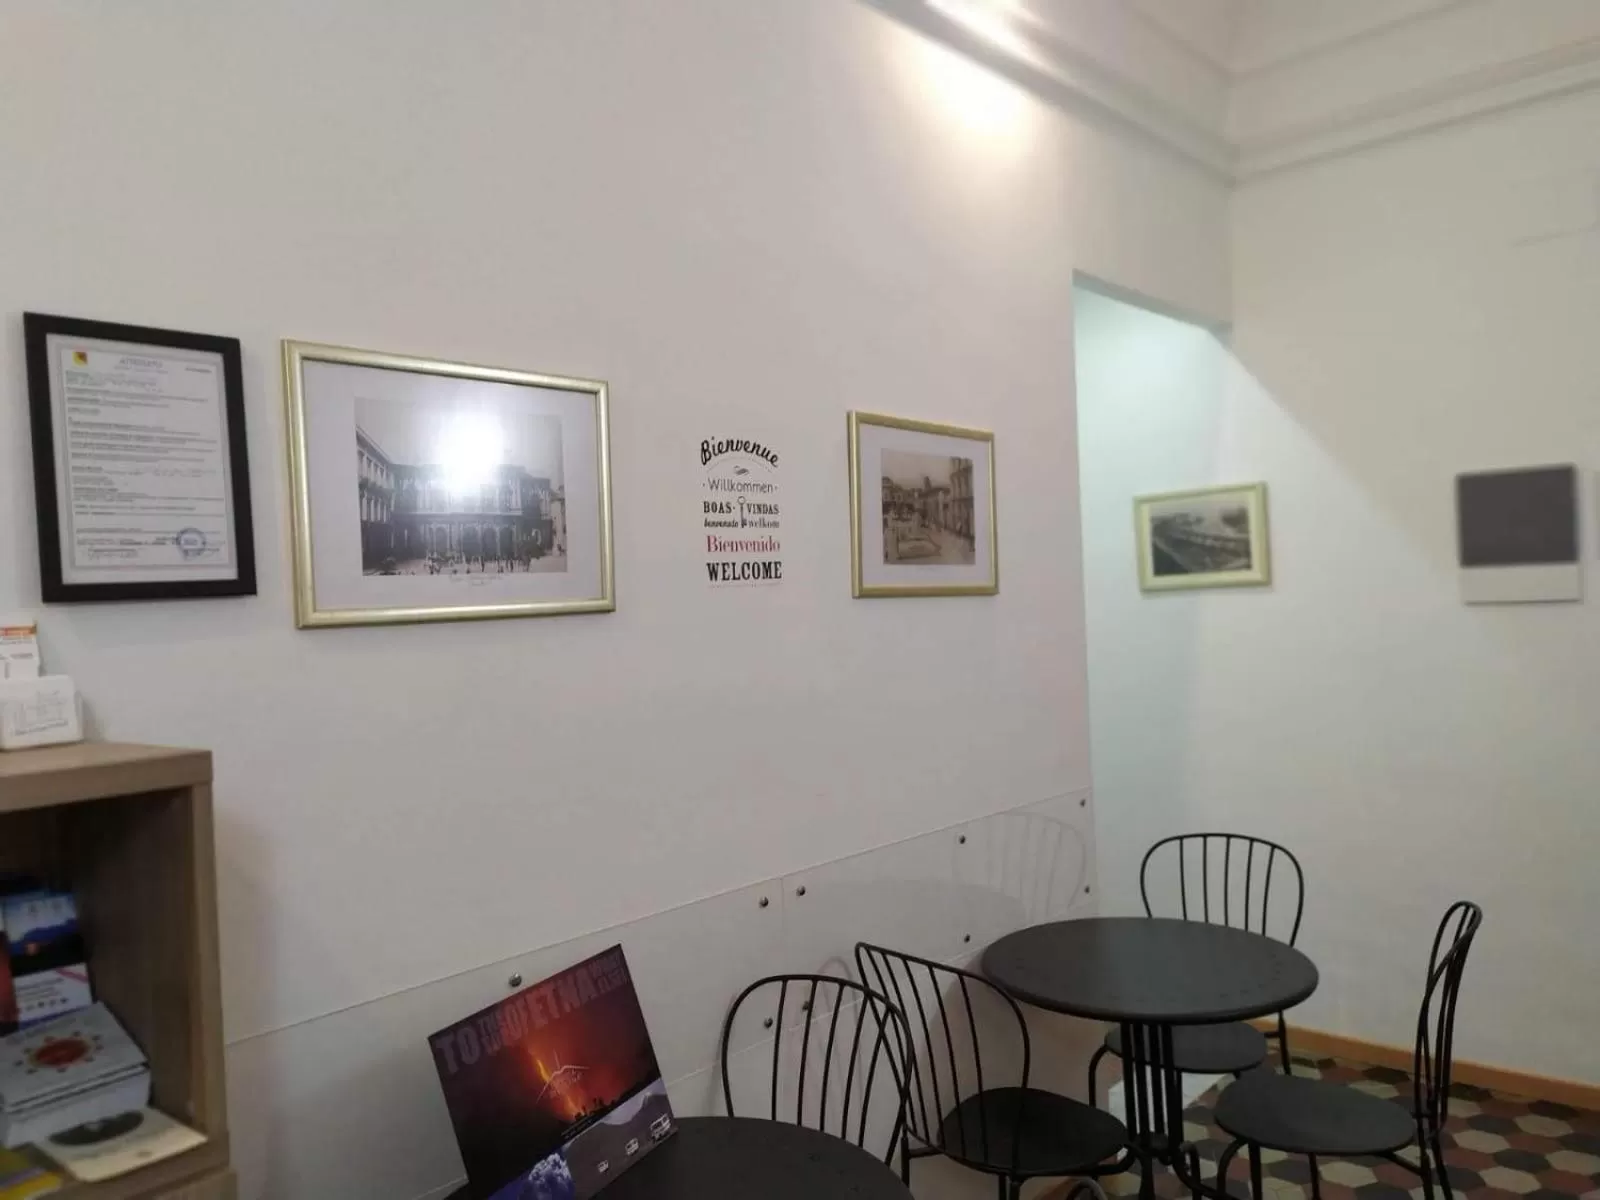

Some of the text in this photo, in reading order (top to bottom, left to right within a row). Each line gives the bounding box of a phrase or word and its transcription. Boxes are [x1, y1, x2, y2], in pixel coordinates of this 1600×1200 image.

[700, 436, 779, 467] Bienvenue
[708, 478, 774, 493] Willkommen
[703, 501, 780, 515] BOAS VINDAS
[706, 534, 781, 553] Bienvenido
[706, 561, 783, 582] WELCOME
[526, 967, 598, 1028] ETNA
